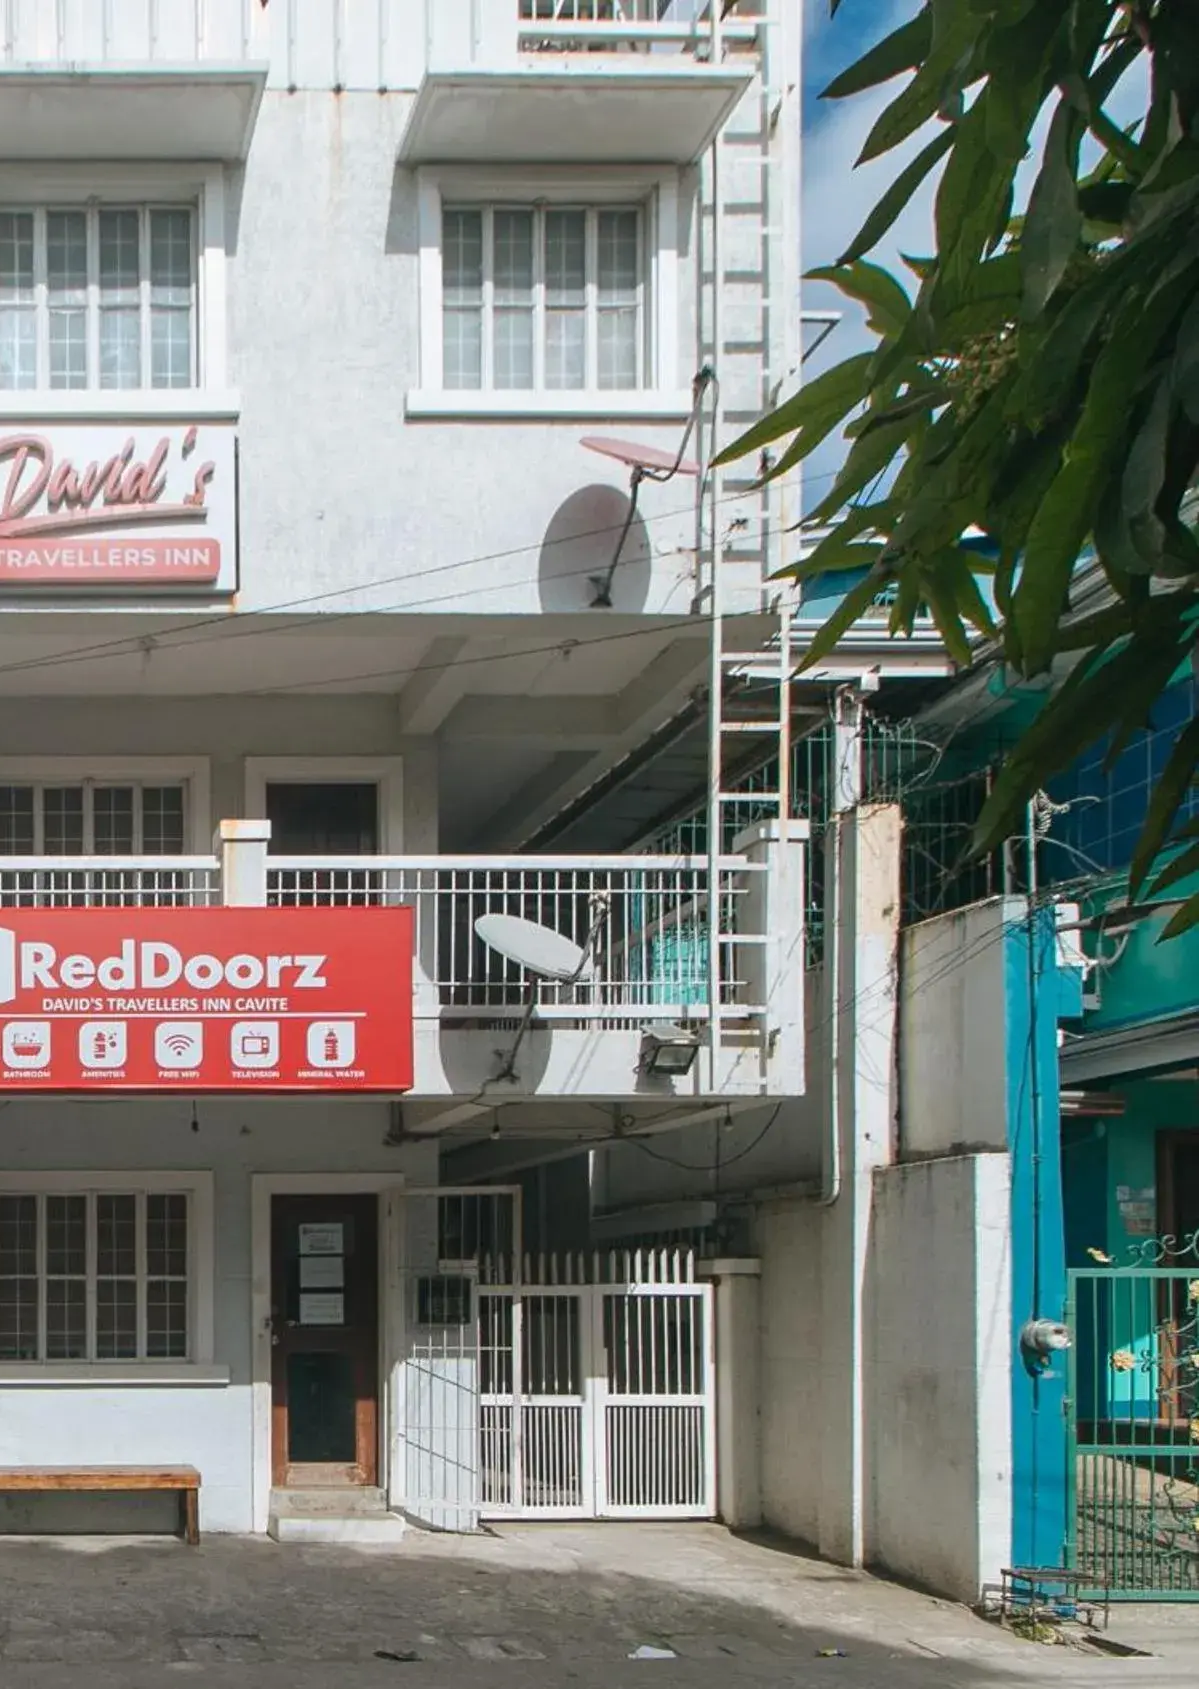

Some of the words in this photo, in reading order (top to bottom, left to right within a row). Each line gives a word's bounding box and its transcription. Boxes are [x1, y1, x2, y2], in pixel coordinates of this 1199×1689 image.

[165, 547, 211, 566] INN
[20, 938, 328, 991] RedDoorz
[42, 997, 103, 1012] DAVID'S
[106, 997, 199, 1012] TRAVELLERS
[202, 998, 231, 1011] INN
[234, 997, 288, 1011] CAVITE
[3, 1070, 50, 1079] BATHROOM
[81, 1070, 126, 1079] AMENITIES
[158, 1070, 179, 1079] FREE
[231, 1070, 280, 1079] TELEVISION
[297, 1070, 333, 1079] MINERAL
[335, 1070, 365, 1079] WATER
